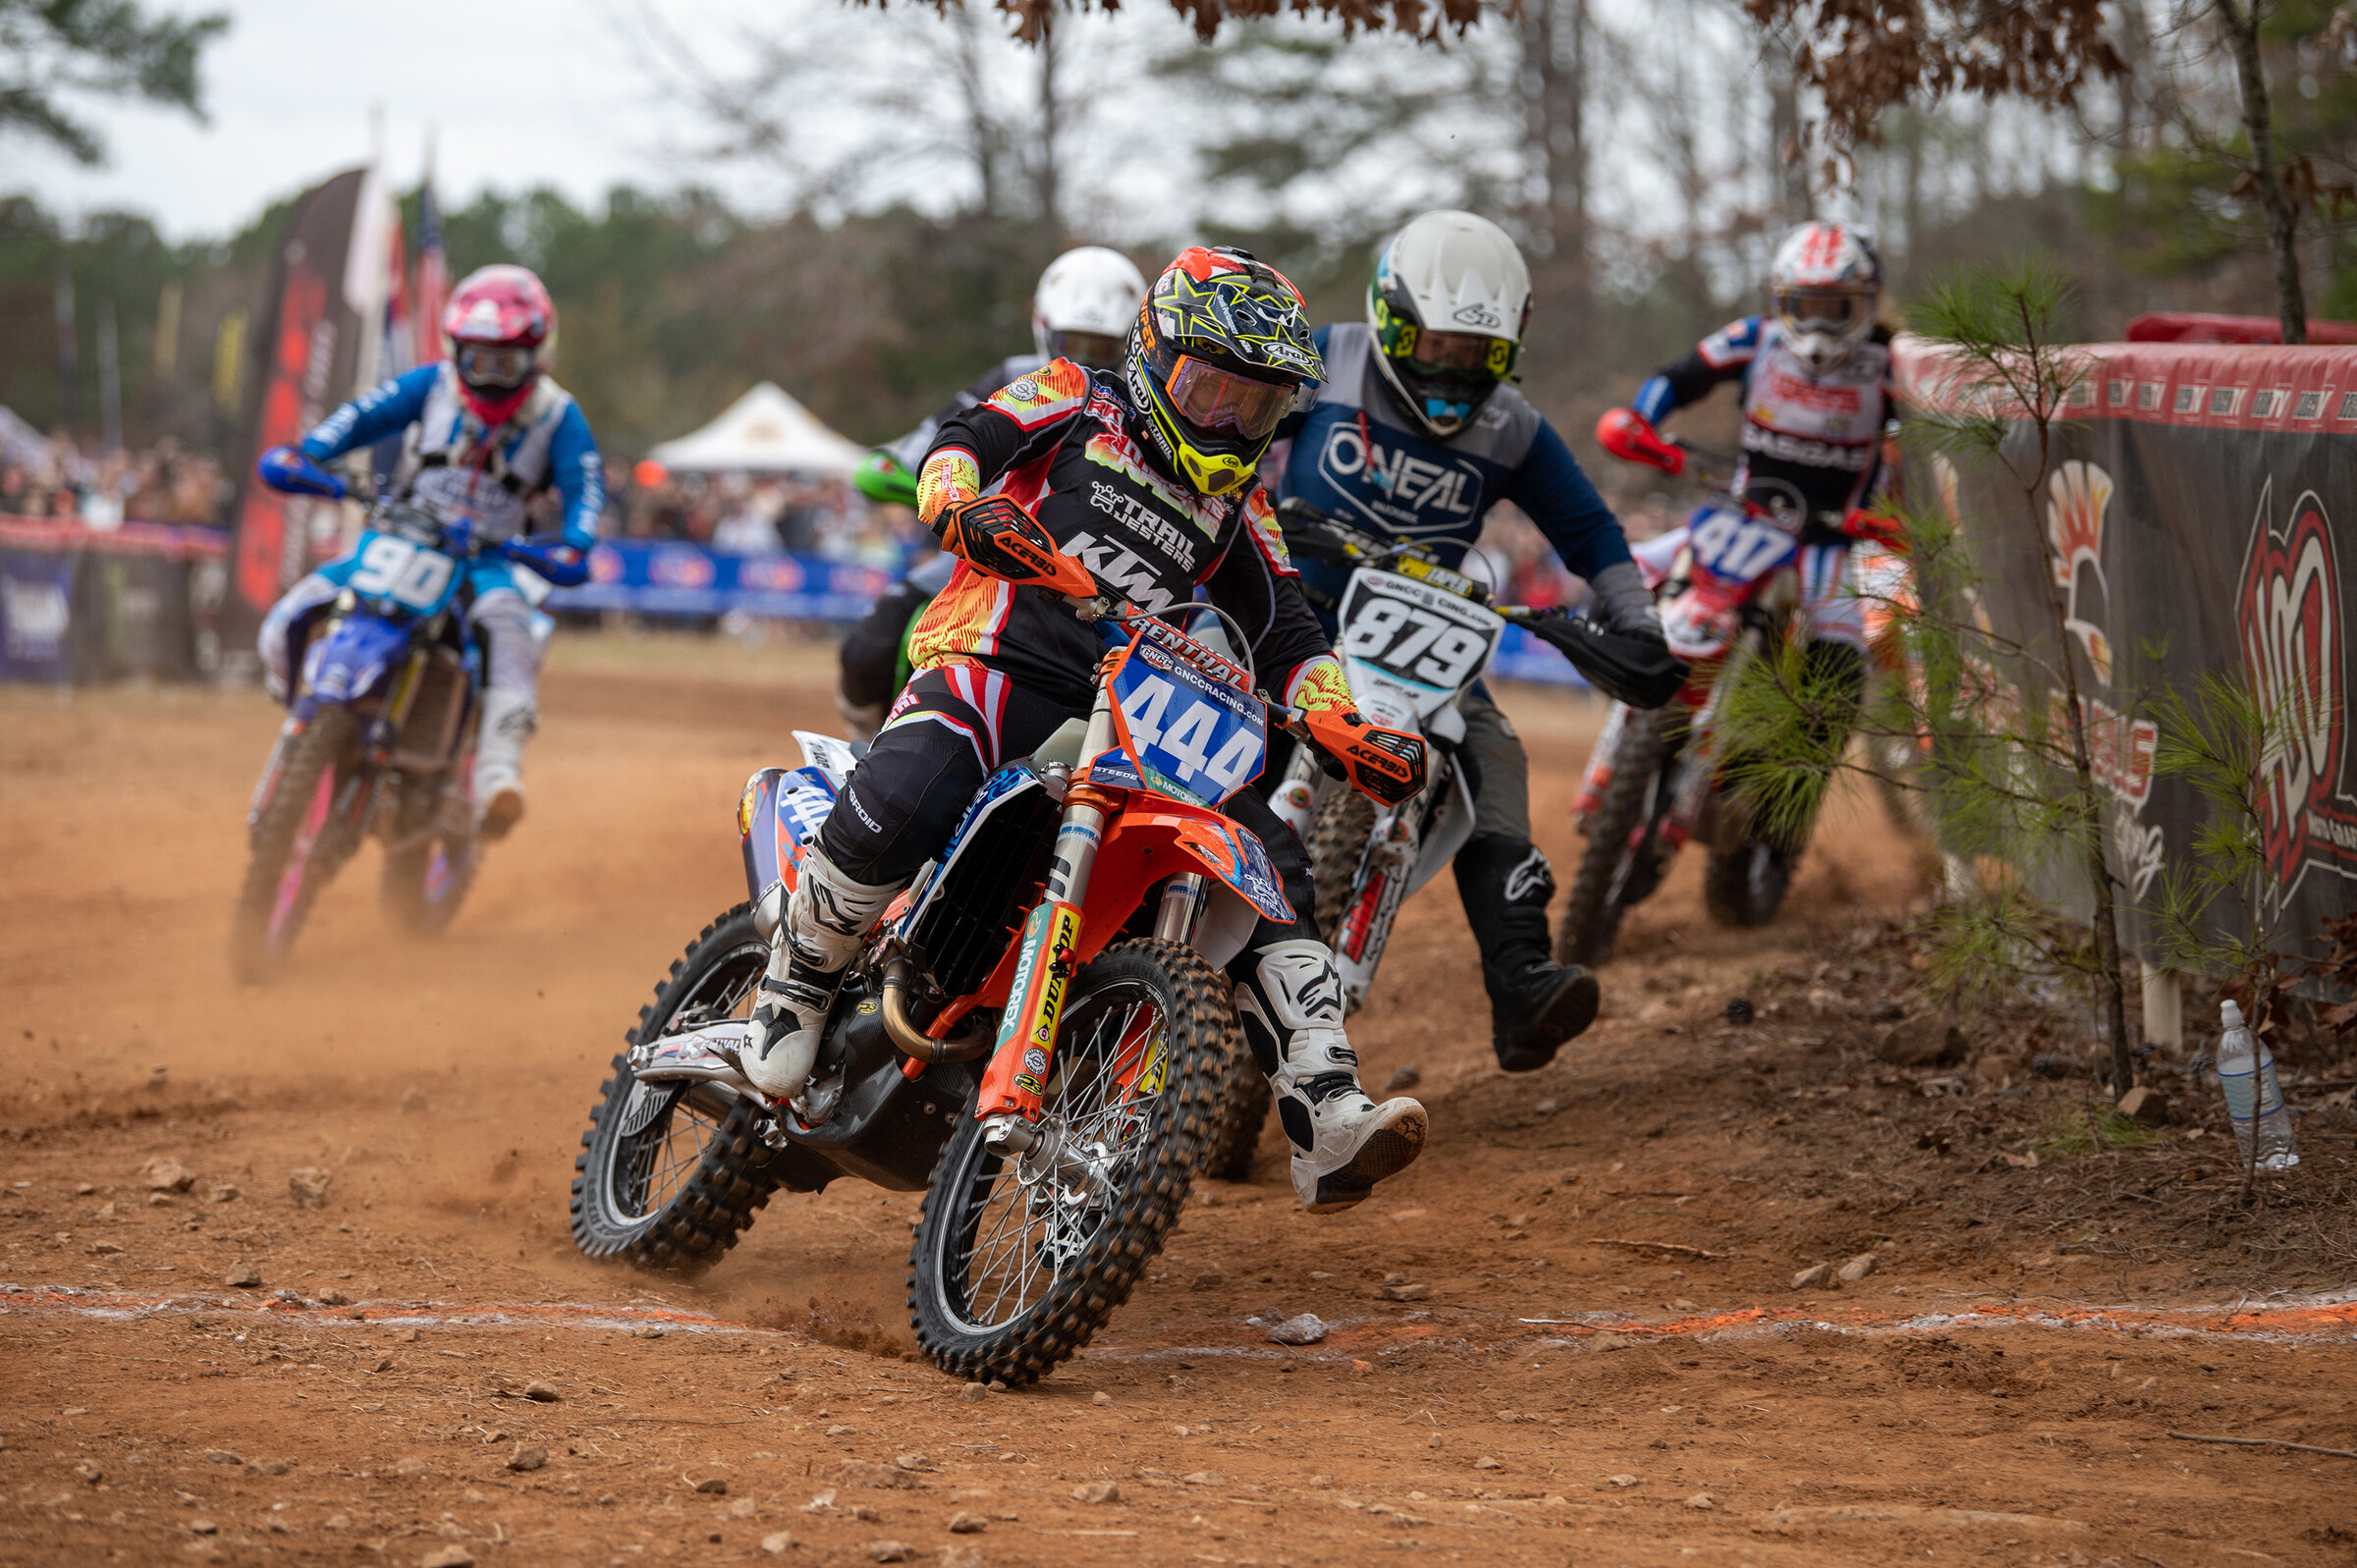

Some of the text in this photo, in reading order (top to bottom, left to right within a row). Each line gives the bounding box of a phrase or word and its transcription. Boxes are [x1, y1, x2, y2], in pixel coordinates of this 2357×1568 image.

[1239, 339, 1253, 354] KTM
[1267, 344, 1307, 362] Arai
[1127, 367, 1148, 406] Arai
[1086, 398, 1124, 425] RK
[1151, 424, 1174, 457] TRAIL
[1112, 511, 1194, 573] JESTERS
[1124, 493, 1196, 565] TRAIL
[350, 534, 454, 610] 90
[998, 536, 1057, 576] ACERBIS
[1059, 531, 1175, 615] KTM
[1386, 580, 1492, 626] GNCCCING.com
[1128, 617, 1244, 691] RENTHAL
[1142, 647, 1174, 670] GNCC
[1345, 598, 1487, 687] 879
[1175, 665, 1264, 727] GNCCRACING.COM
[1121, 674, 1264, 803] 444
[1345, 744, 1408, 779] ACERBIS
[1093, 765, 1138, 782] STEEDE
[1162, 781, 1204, 808] MOTOREX
[1002, 939, 1037, 1030] MOTOREX
[1043, 914, 1073, 1024] DUNOP
